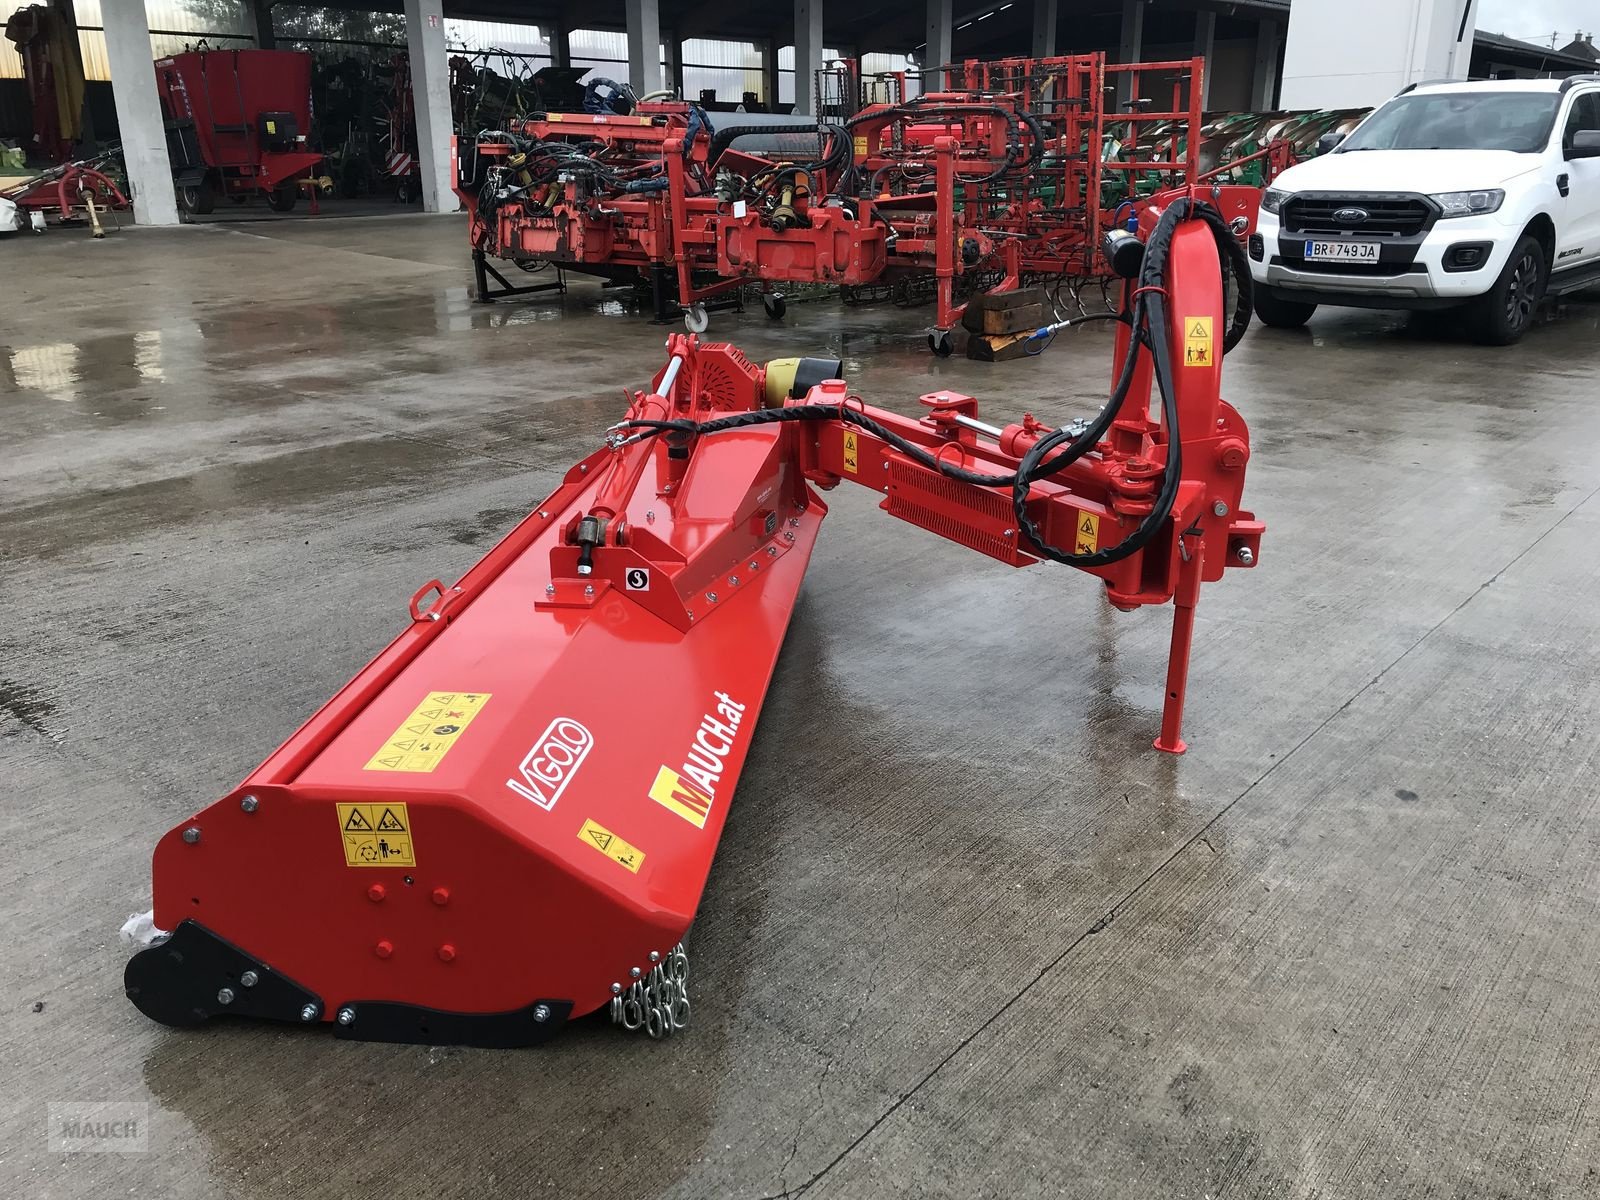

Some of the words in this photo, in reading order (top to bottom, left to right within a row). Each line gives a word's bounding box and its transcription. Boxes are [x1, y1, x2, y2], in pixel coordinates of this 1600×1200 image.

[1314, 243, 1328, 256] BR
[1336, 244, 1358, 257] 749
[1360, 245, 1375, 258] JA
[505, 716, 594, 811] VIGOLO
[670, 690, 746, 818] MAUCH.at
